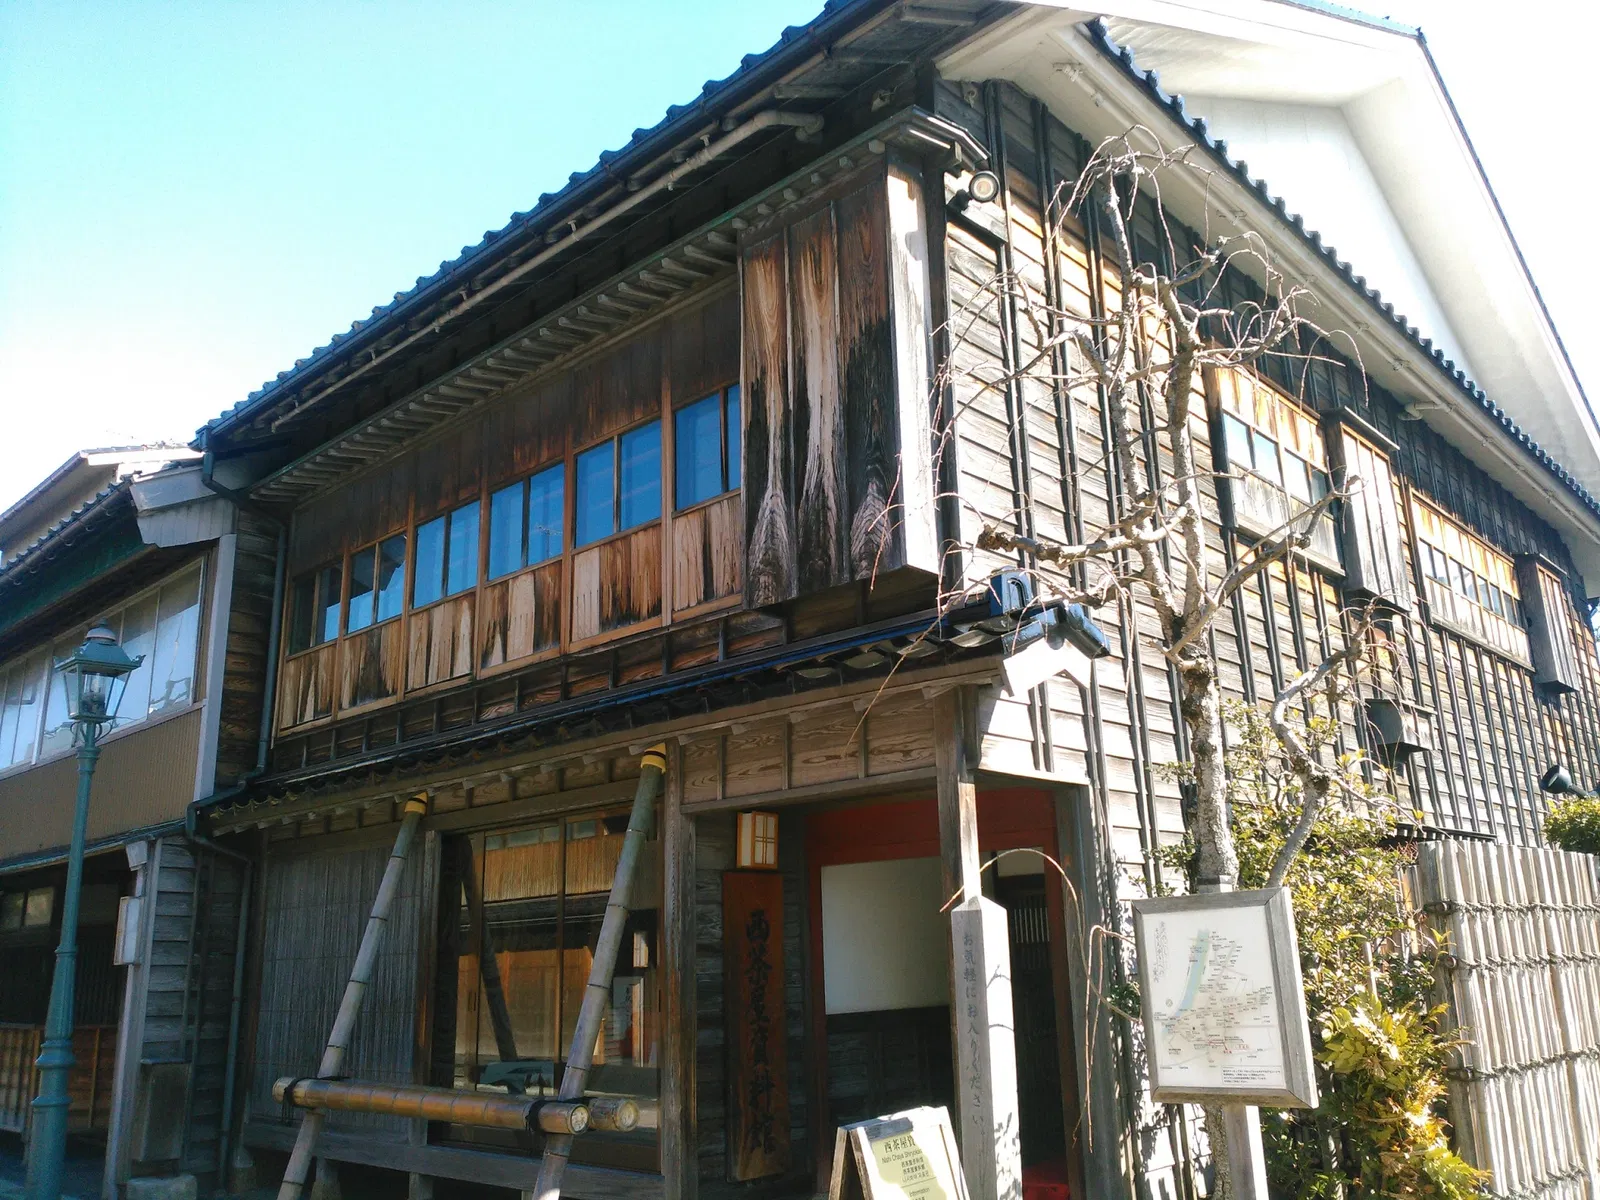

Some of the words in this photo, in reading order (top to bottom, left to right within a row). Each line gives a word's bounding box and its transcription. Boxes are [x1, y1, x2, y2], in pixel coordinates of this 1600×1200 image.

[745, 908, 775, 1155] 西茶屋資料館
